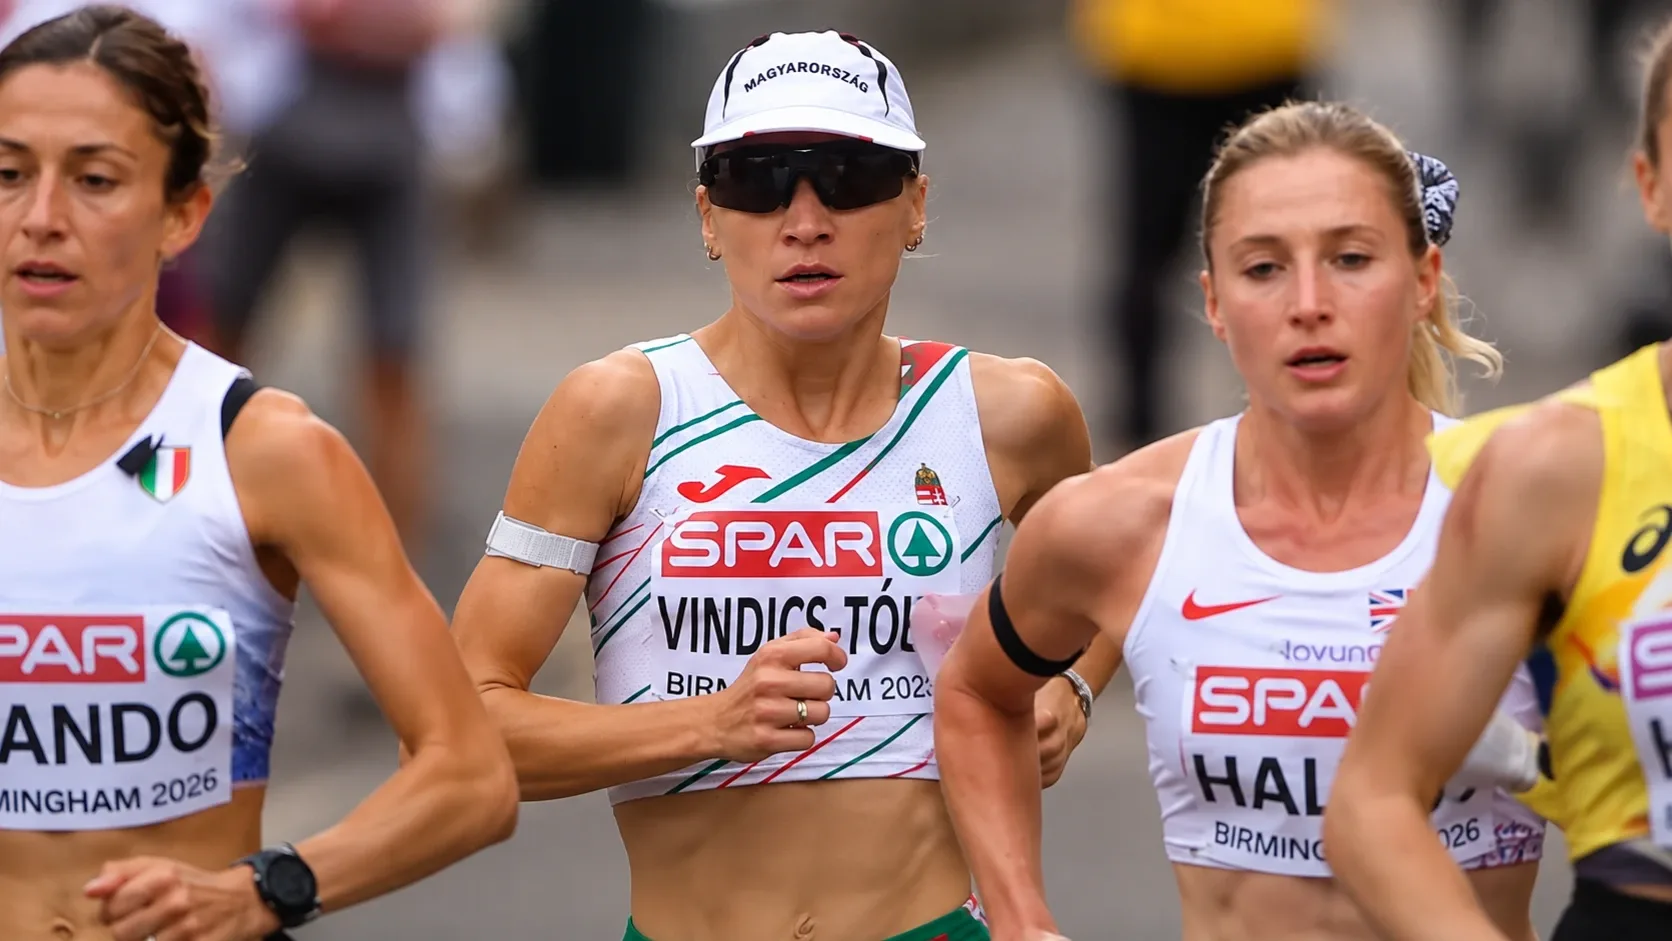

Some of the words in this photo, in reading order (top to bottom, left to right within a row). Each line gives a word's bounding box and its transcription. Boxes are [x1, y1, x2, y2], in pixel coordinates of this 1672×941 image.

[743, 61, 869, 93] MAGYARORSZÁG
[669, 520, 876, 568] SPAR
[1199, 675, 1370, 728] SPA
[0, 691, 218, 765] ANDO
[152, 767, 217, 807] 2026
